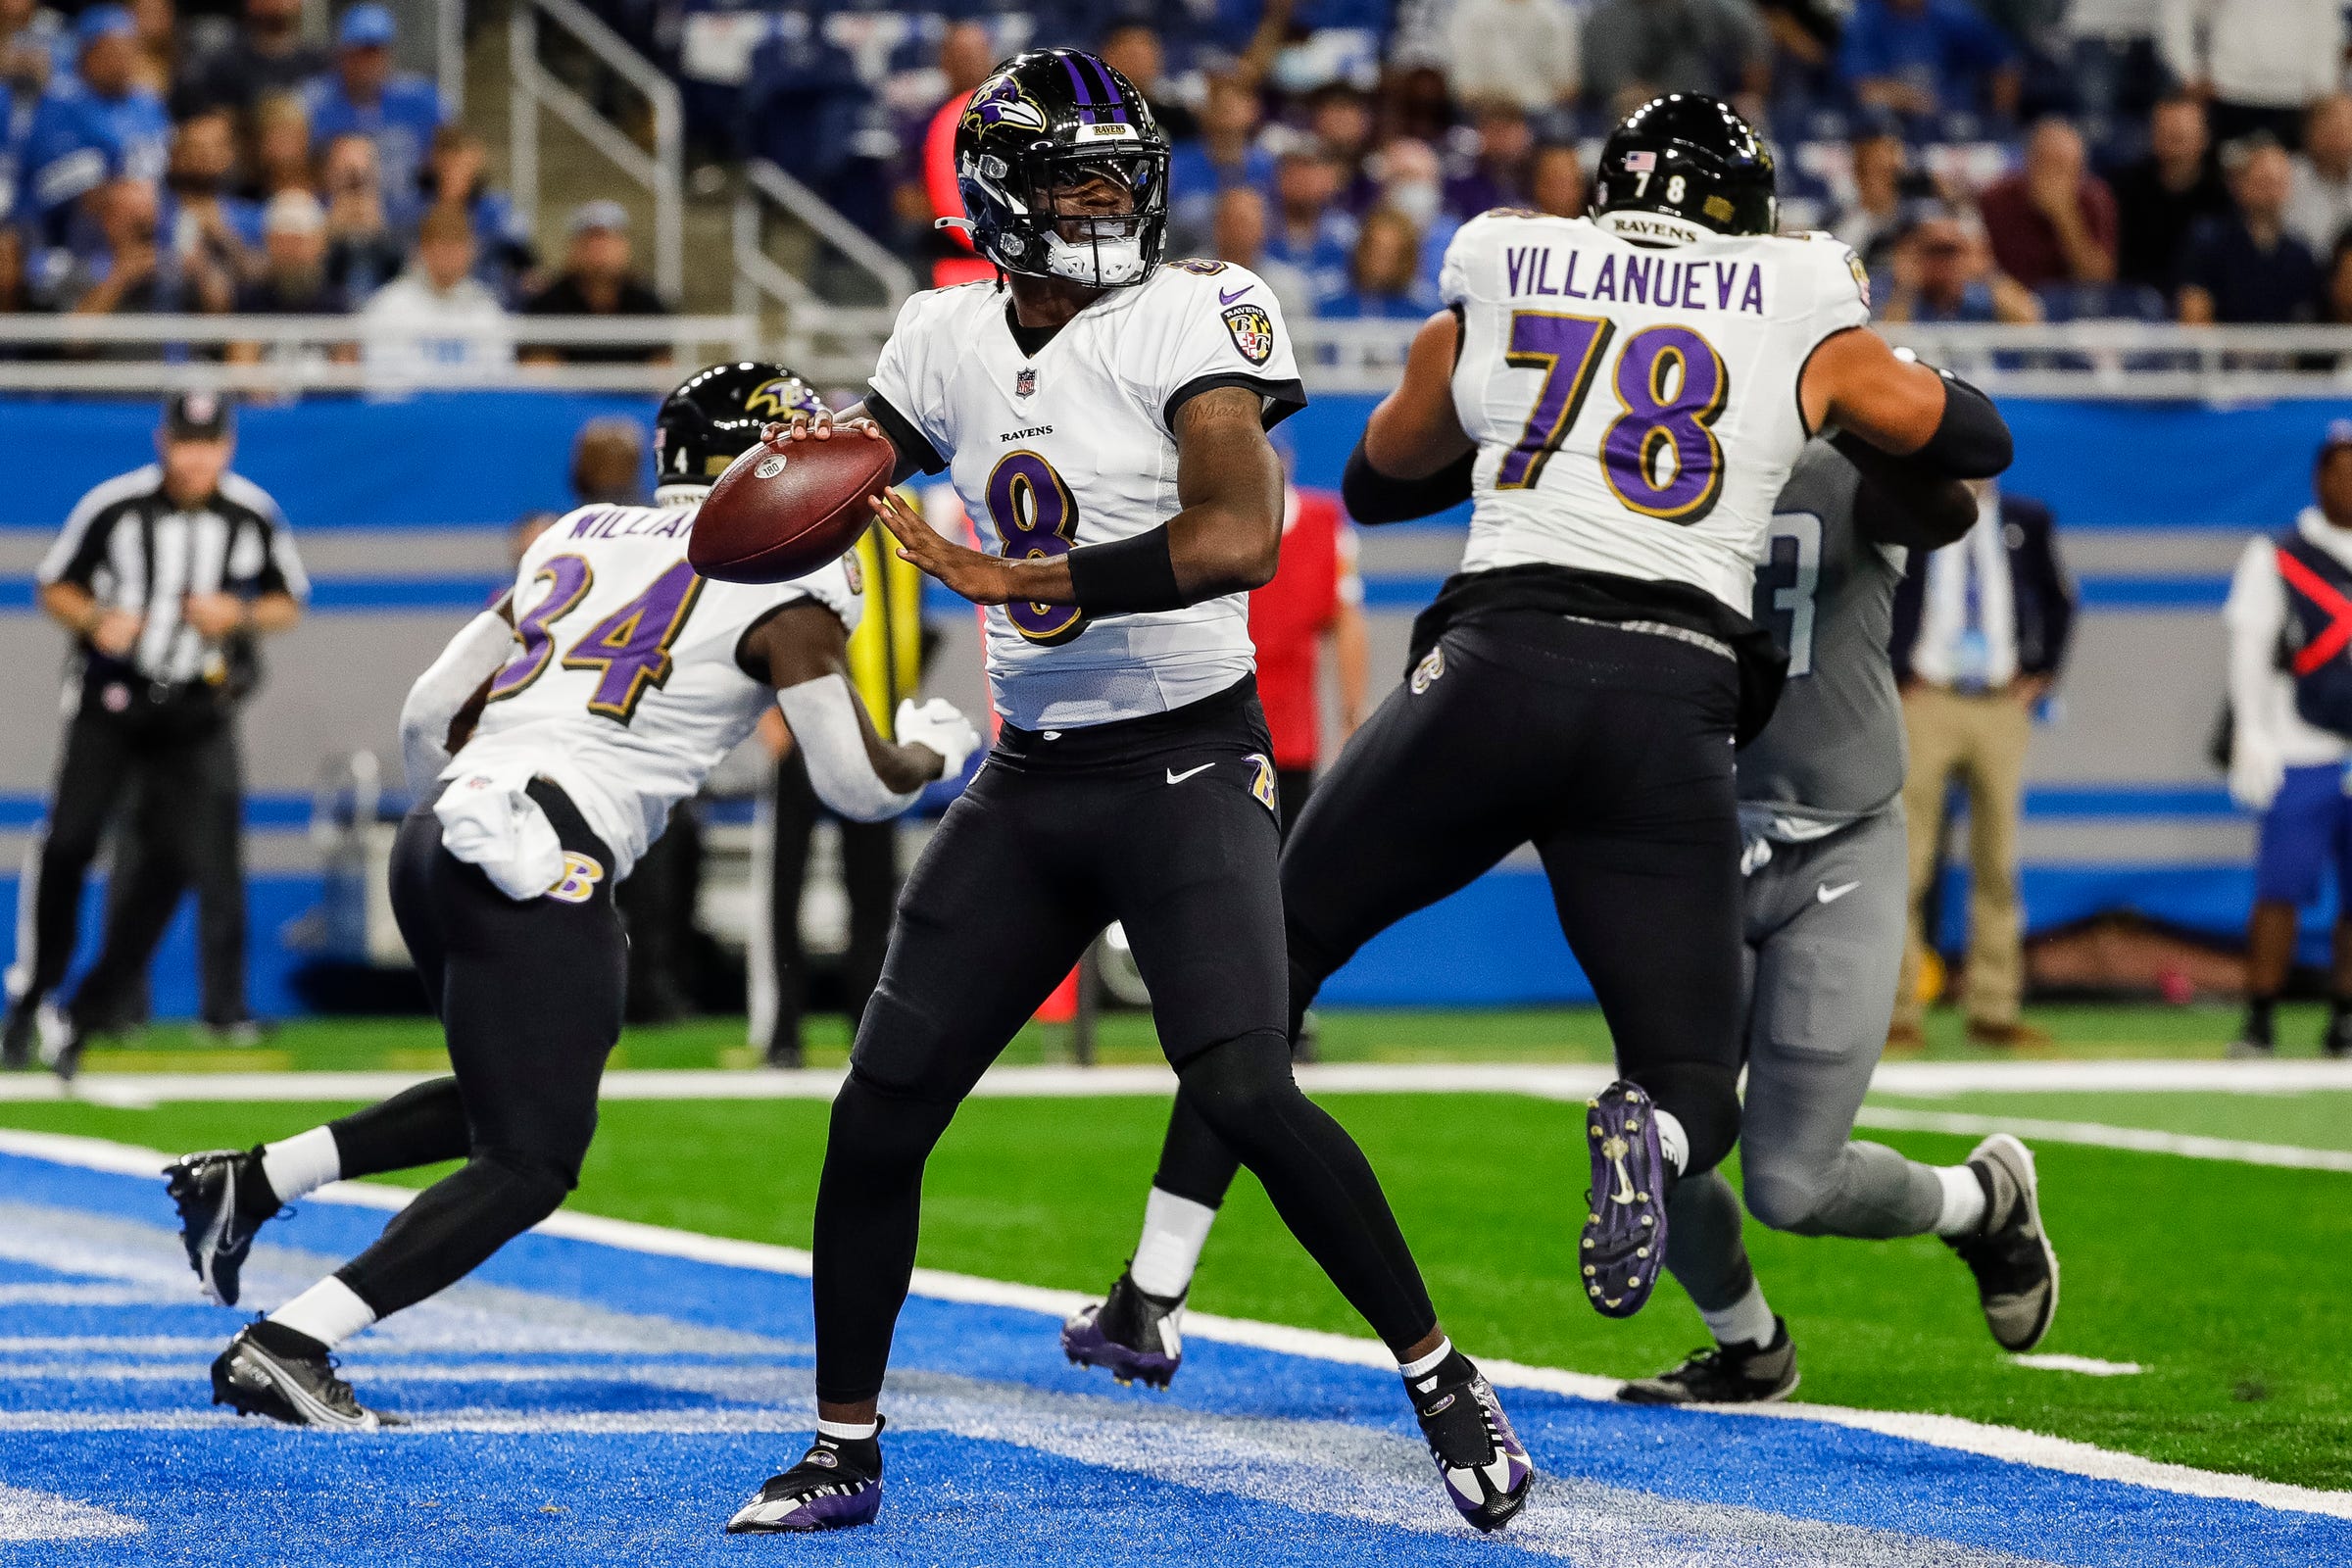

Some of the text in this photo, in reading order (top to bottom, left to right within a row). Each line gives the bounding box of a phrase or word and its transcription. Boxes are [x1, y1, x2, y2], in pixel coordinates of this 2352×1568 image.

[1093, 124, 1126, 135] RAVENS
[1613, 219, 1698, 243] RAVENS
[1506, 246, 1764, 316] VILLANUEVA
[1223, 306, 1266, 319] RAVENS
[1495, 310, 1729, 526] 78
[1000, 424, 1054, 443] RAVENS
[763, 462, 781, 477] 180
[567, 510, 696, 539] WILLIA
[985, 449, 1094, 648] 8
[486, 554, 709, 728] 34
